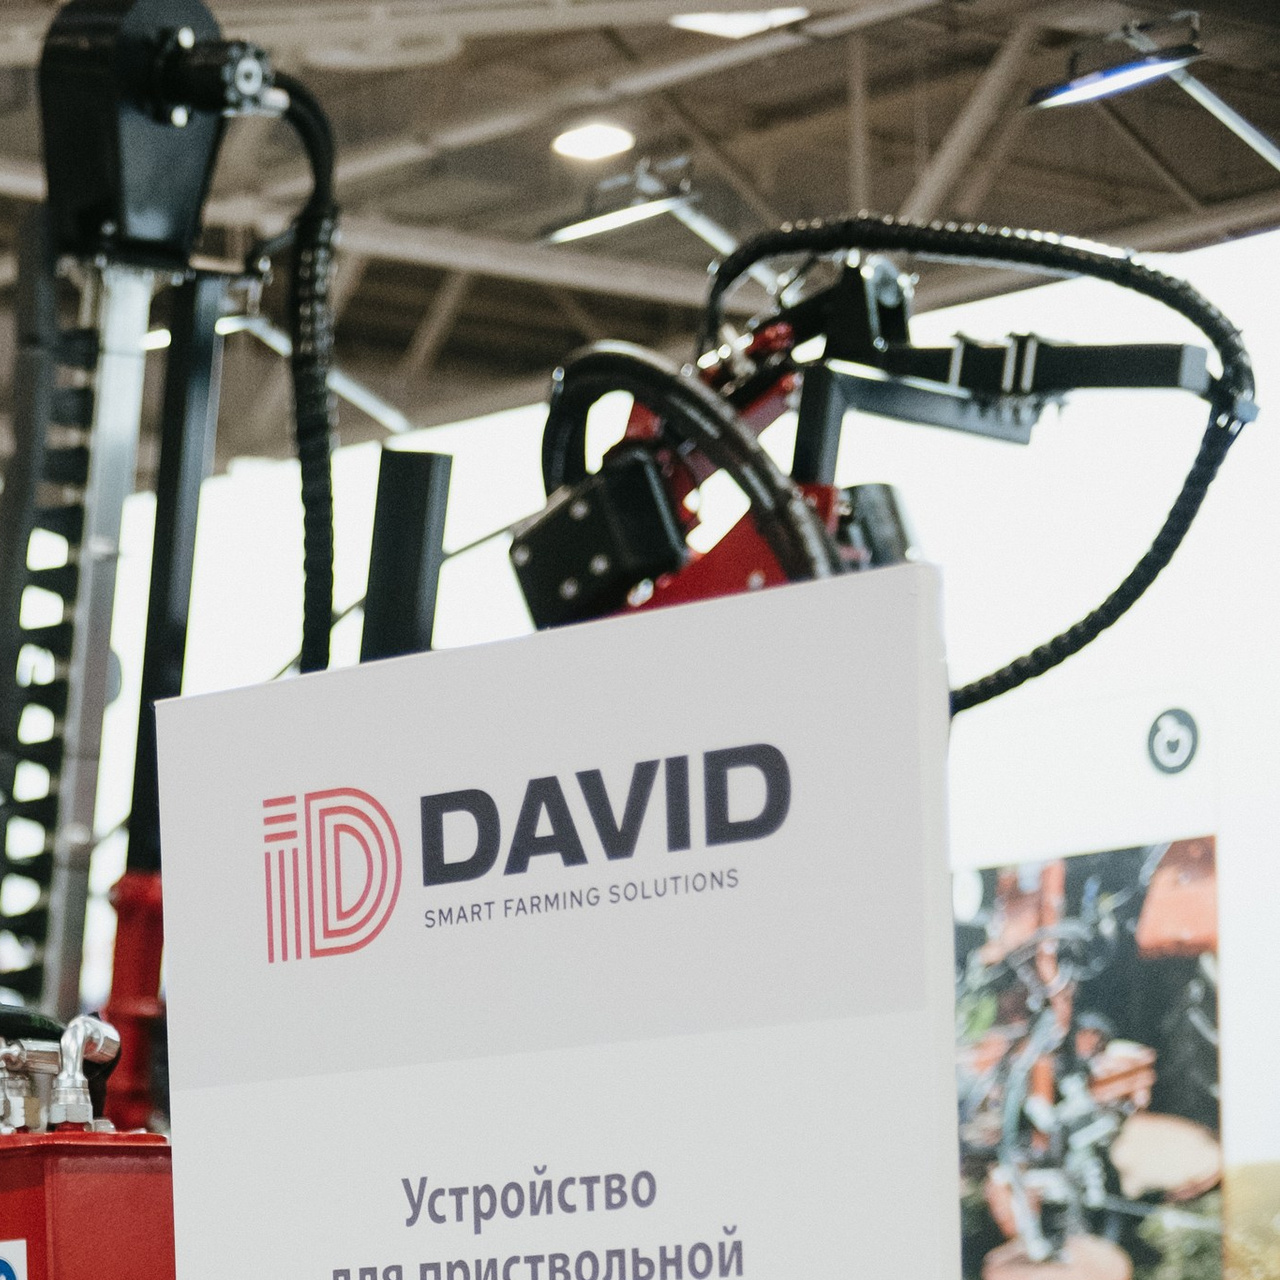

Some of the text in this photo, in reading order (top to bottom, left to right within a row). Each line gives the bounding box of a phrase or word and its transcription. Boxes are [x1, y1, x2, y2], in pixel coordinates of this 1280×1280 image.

[420, 743, 792, 887] DAVID
[424, 867, 740, 929] SMART FARMING SOLUTIONS
[401, 1164, 657, 1235] Устройство
